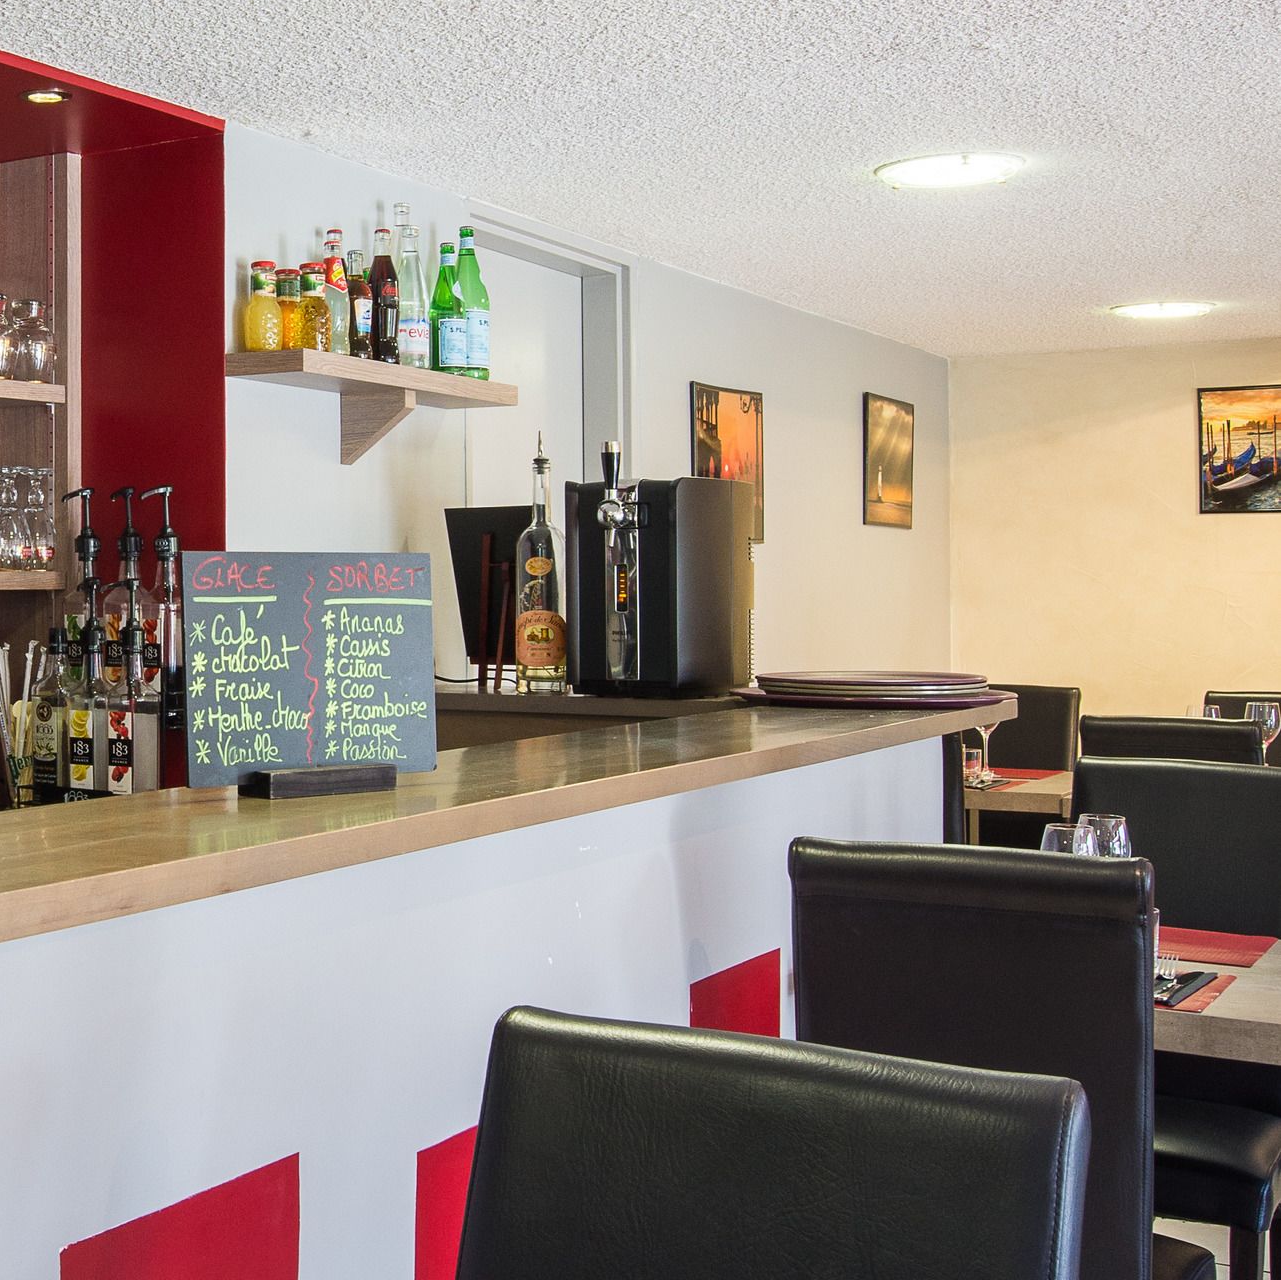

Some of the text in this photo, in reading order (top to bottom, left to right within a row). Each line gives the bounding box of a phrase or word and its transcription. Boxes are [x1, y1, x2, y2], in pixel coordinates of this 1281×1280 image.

[408, 326, 429, 339] evia
[192, 557, 275, 593] GLACE
[326, 561, 425, 593] SORBET
[211, 604, 264, 646] Café
[340, 606, 405, 636] Ananas
[340, 633, 391, 657] Cassis
[337, 658, 391, 679] Citron
[215, 677, 274, 702] Fraise
[340, 679, 375, 699] Coco
[340, 692, 427, 721] Framboise
[340, 720, 401, 747] Mangue
[217, 733, 283, 766] Vanille
[342, 737, 406, 761] Passion
